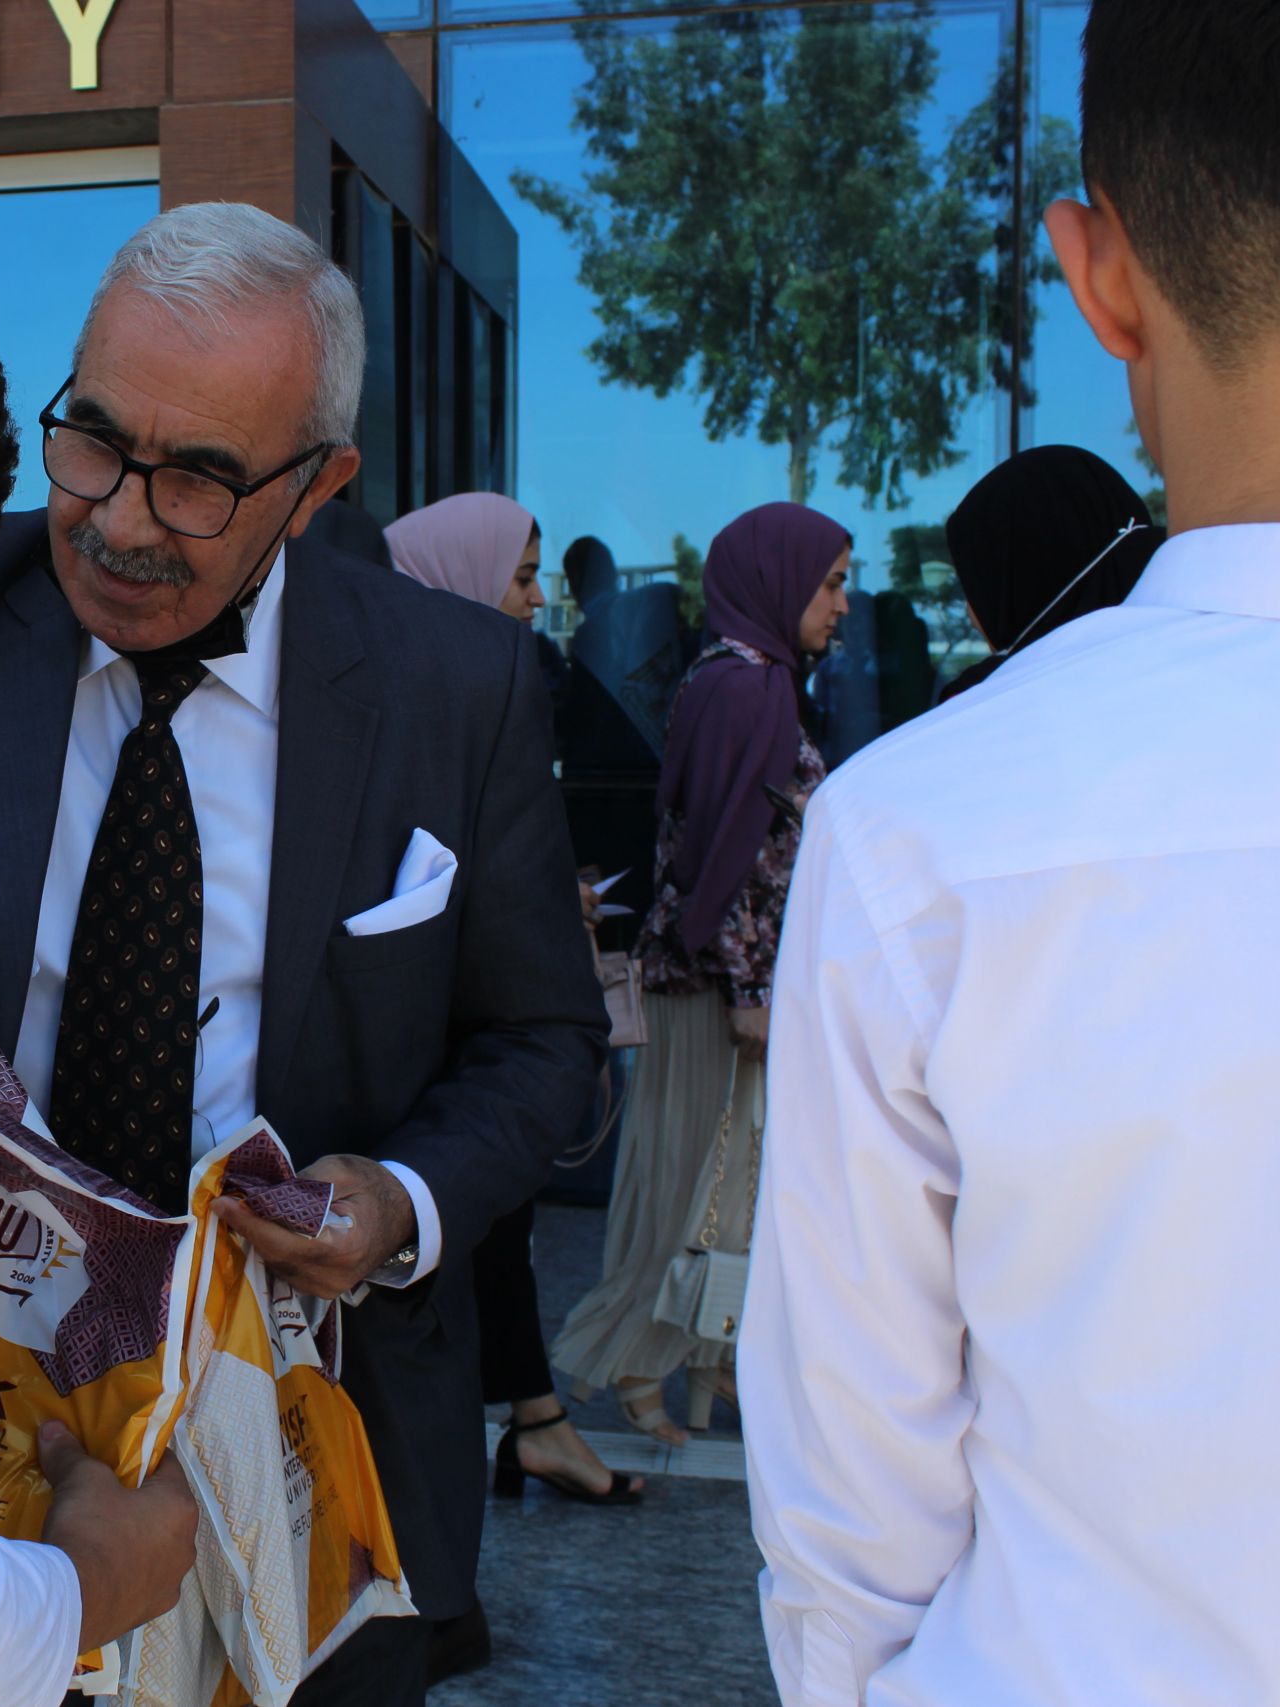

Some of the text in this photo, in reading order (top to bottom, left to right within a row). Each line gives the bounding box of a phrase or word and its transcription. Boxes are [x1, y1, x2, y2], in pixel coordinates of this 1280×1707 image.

[41, 1225, 55, 1264] RSITY
[9, 1269, 36, 1286] 2008
[278, 1310, 301, 1319] 2008
